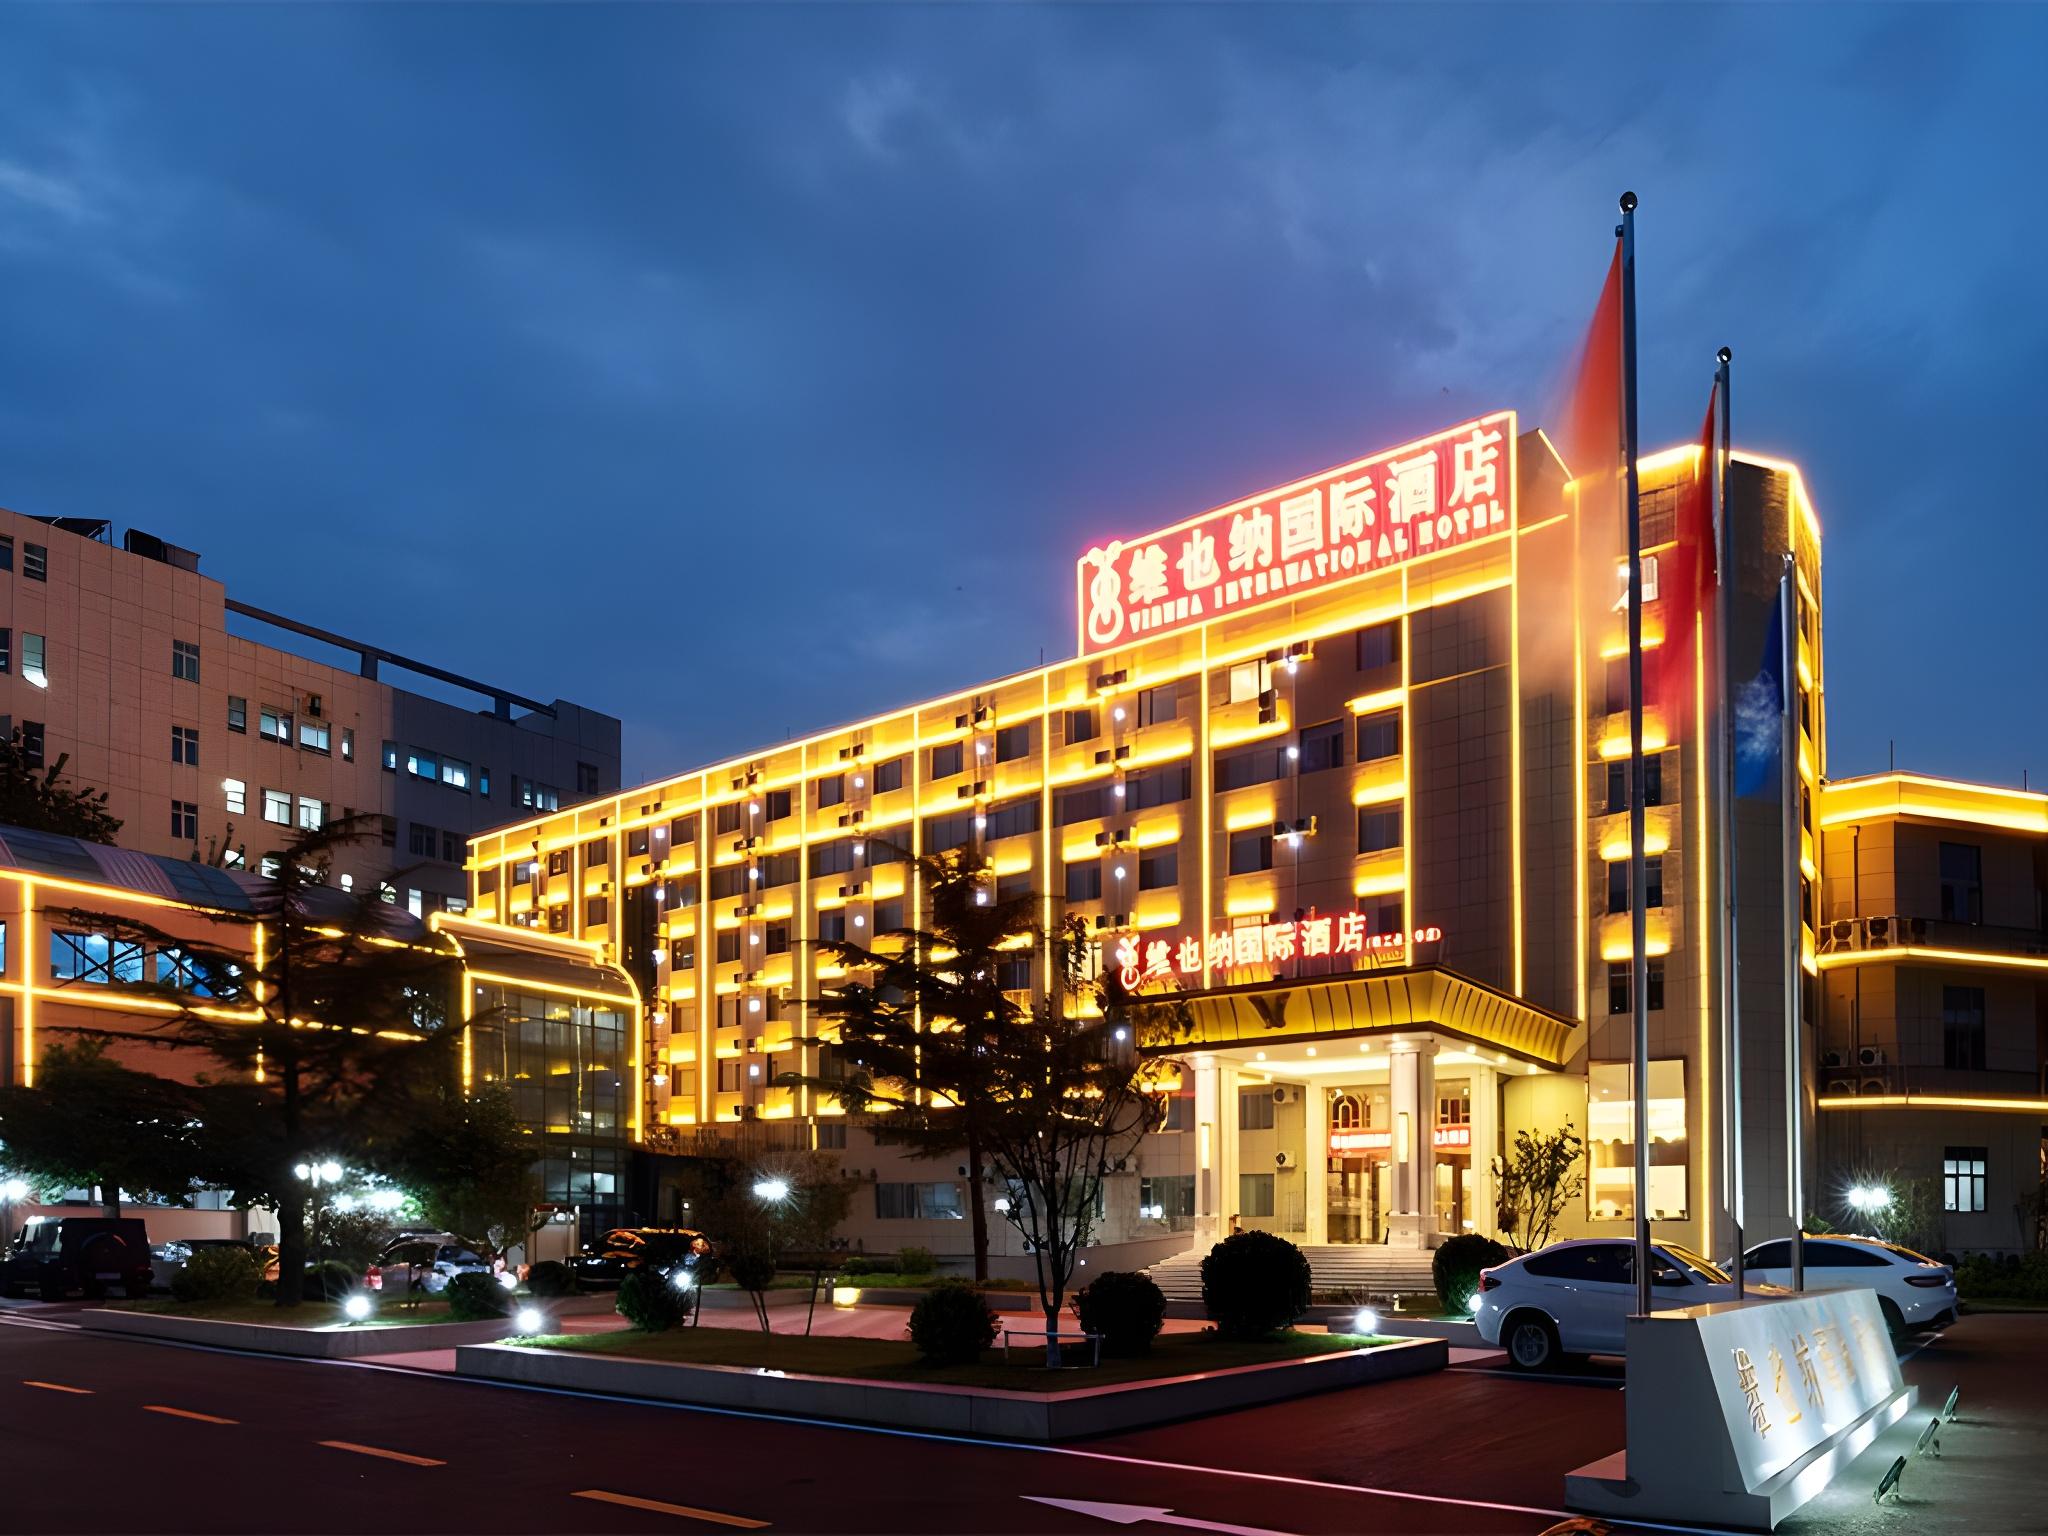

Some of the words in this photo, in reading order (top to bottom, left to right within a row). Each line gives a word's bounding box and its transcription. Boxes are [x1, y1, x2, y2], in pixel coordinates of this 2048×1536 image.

[1128, 428, 1503, 605] 维也纳国际酒店
[1213, 527, 1409, 609] INTERNATIONAL
[1417, 499, 1505, 546] HOTEL
[1145, 911, 1367, 977] 维也纳国际酒店
